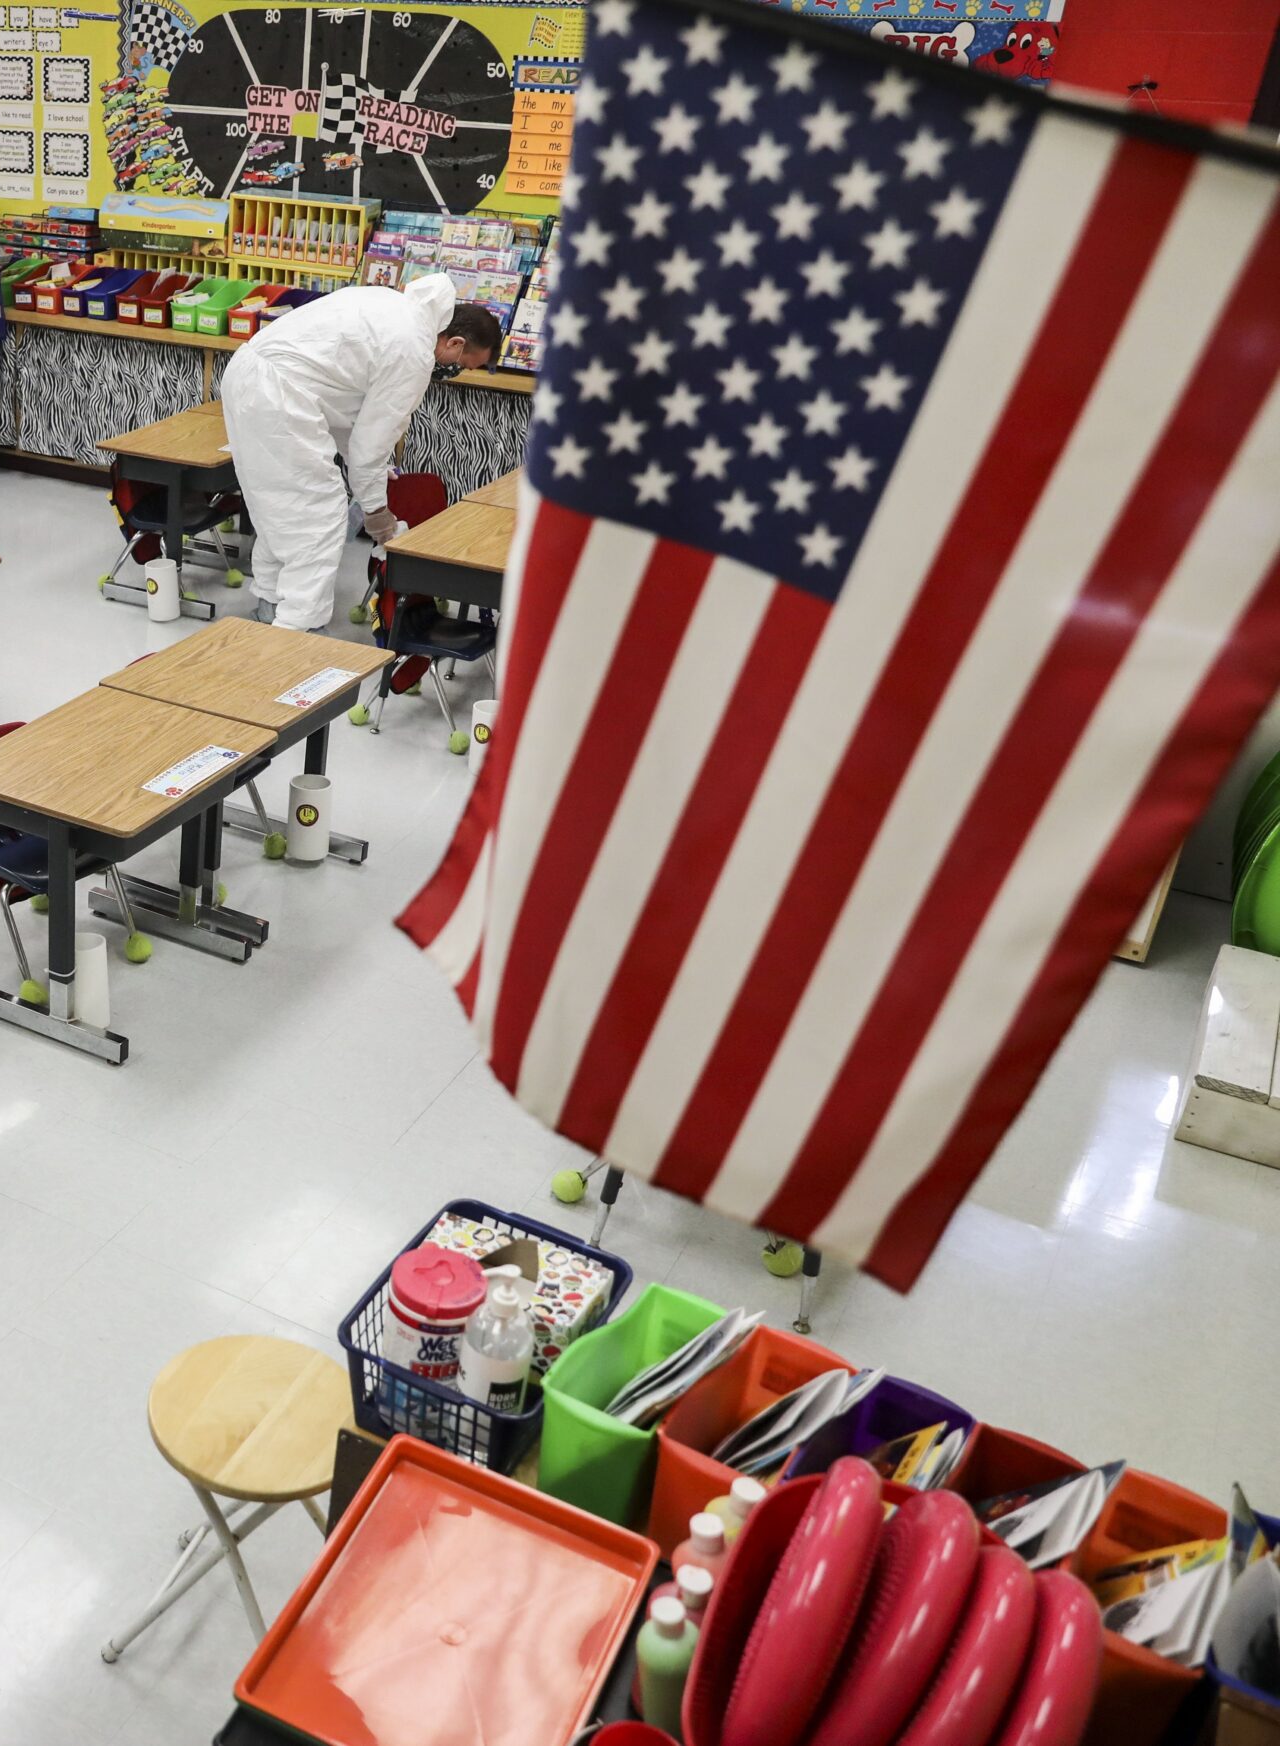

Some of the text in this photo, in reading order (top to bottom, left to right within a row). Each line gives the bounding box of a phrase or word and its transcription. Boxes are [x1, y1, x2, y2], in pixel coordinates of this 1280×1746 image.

[265, 9, 281, 24] 80
[393, 12, 411, 27] 60
[187, 39, 204, 54] 90
[486, 62, 505, 78] 50
[246, 85, 320, 113] GET ON
[521, 95, 566, 112] the my
[247, 112, 290, 135] THE
[358, 95, 456, 137] READING
[225, 123, 247, 138] 100
[550, 120, 564, 133] go
[364, 121, 426, 155] RACE
[520, 139, 562, 151] a me
[168, 126, 215, 198] START
[517, 155, 562, 171] to like
[476, 174, 496, 190] 40
[516, 177, 525, 189] is
[420, 1336, 459, 1352] Wet
[417, 1349, 457, 1362] Ones
[410, 1360, 460, 1379] BIG
